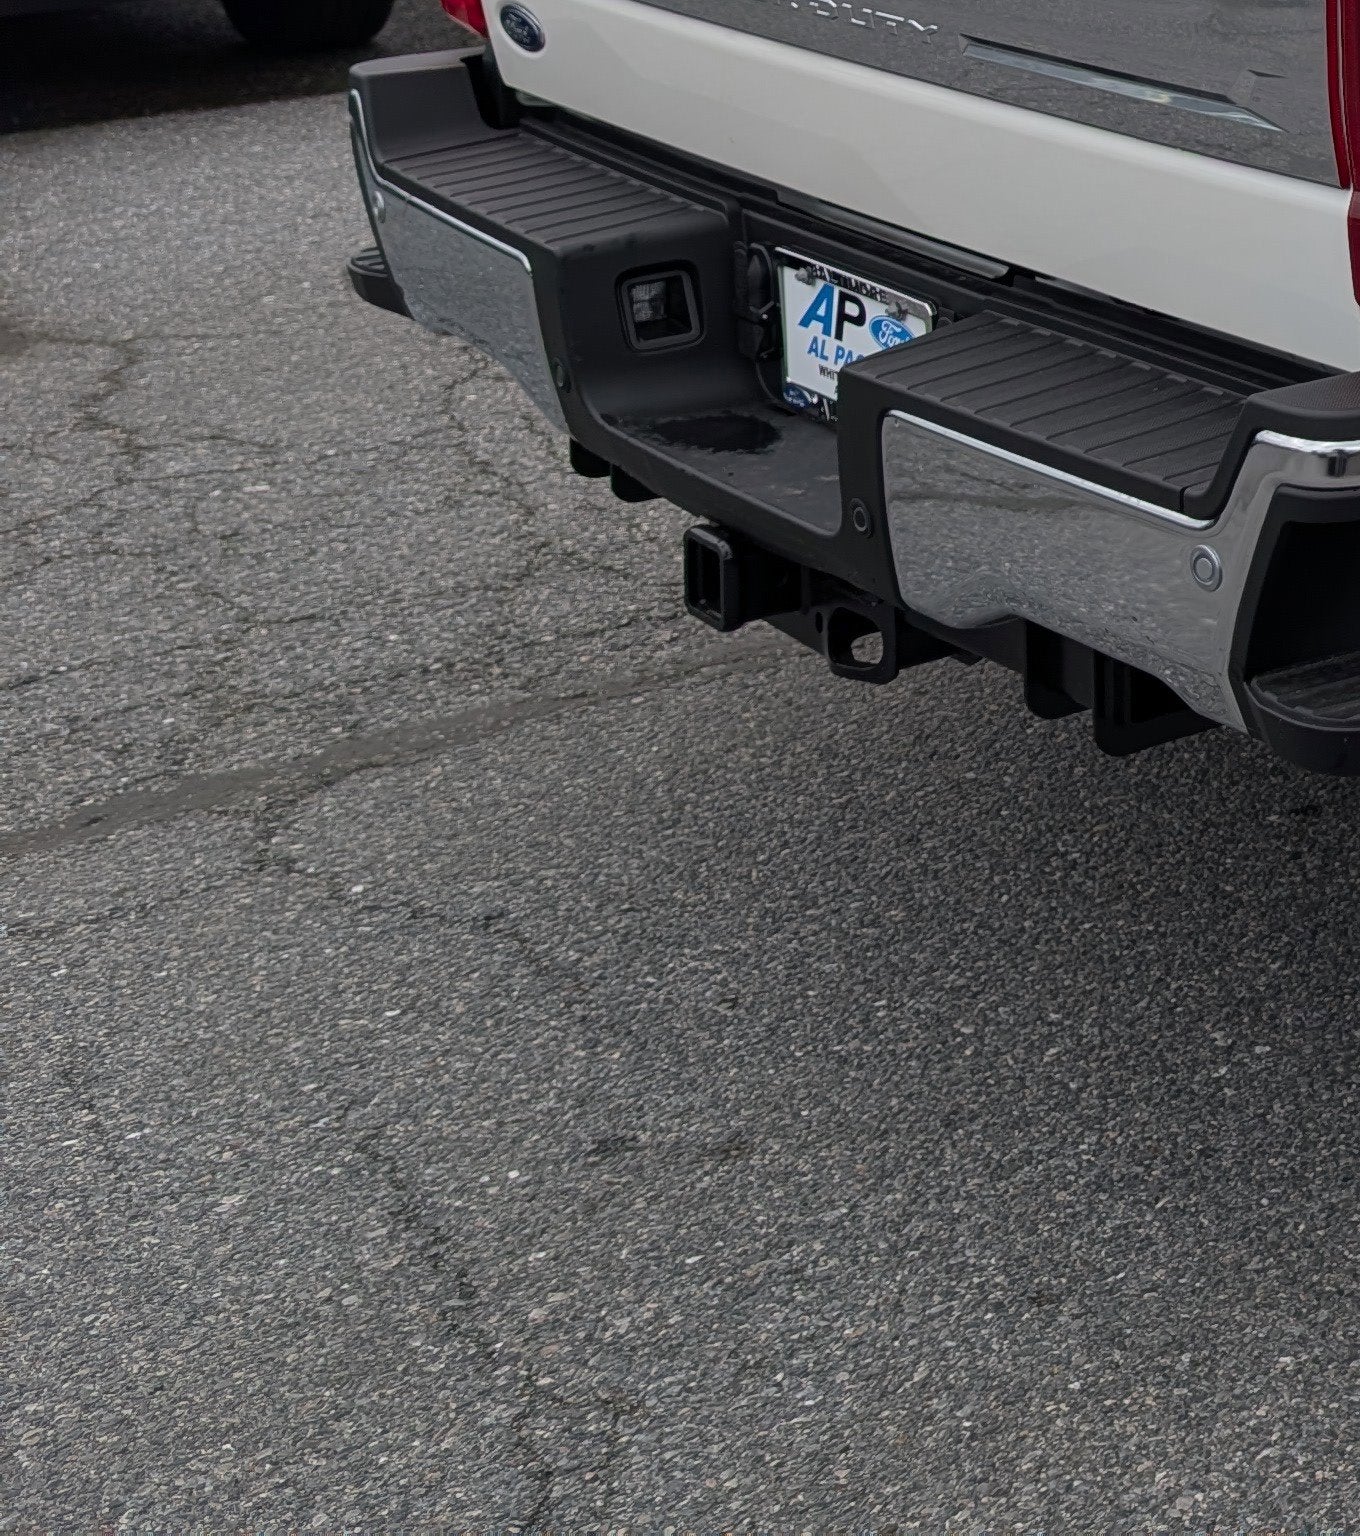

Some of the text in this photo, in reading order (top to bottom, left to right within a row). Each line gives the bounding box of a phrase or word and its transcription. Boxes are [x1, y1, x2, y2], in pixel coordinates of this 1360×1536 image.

[799, 282, 867, 342] AP
[807, 335, 866, 366] AL PA
